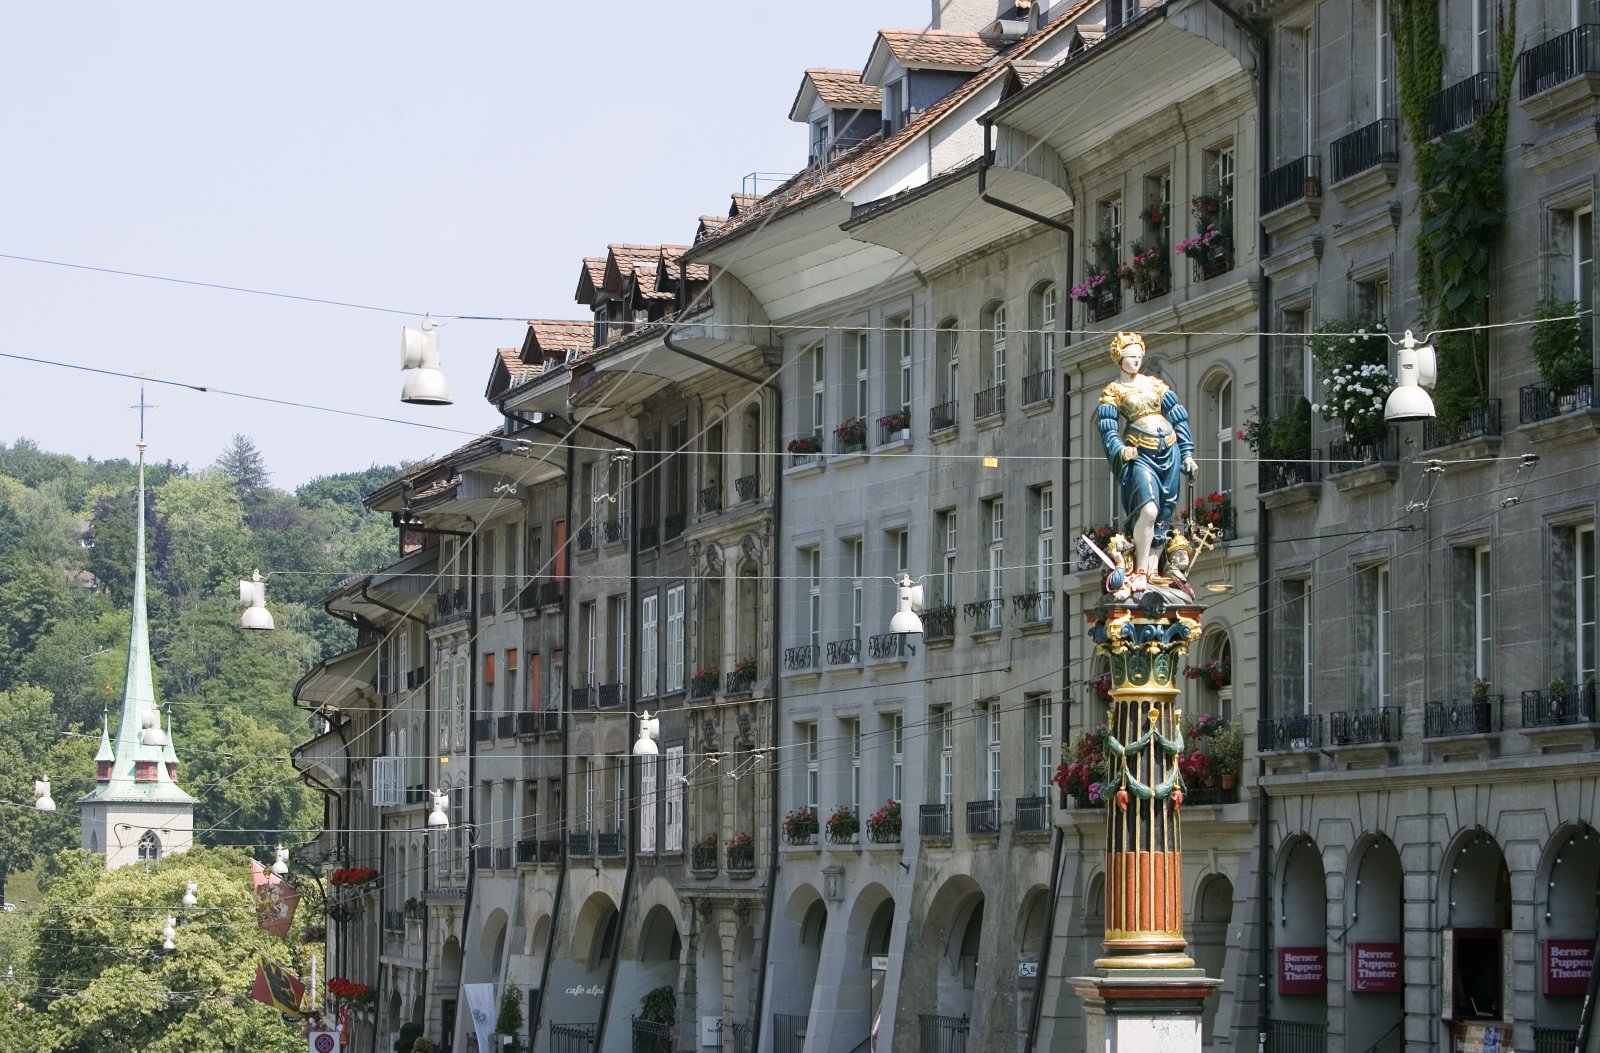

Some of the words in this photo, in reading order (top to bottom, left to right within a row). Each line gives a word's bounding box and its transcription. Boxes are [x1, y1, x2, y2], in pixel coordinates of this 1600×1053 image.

[1358, 950, 1394, 959] Berner
[1551, 947, 1590, 956] Berner
[1284, 953, 1319, 962] Berner
[1284, 962, 1324, 973] Puppen-
[1358, 959, 1400, 970] Puppen-
[1284, 972, 1322, 981] Theater
[1357, 969, 1397, 978] Theater
[1550, 968, 1592, 978] Theater
[565, 984, 585, 997] café
